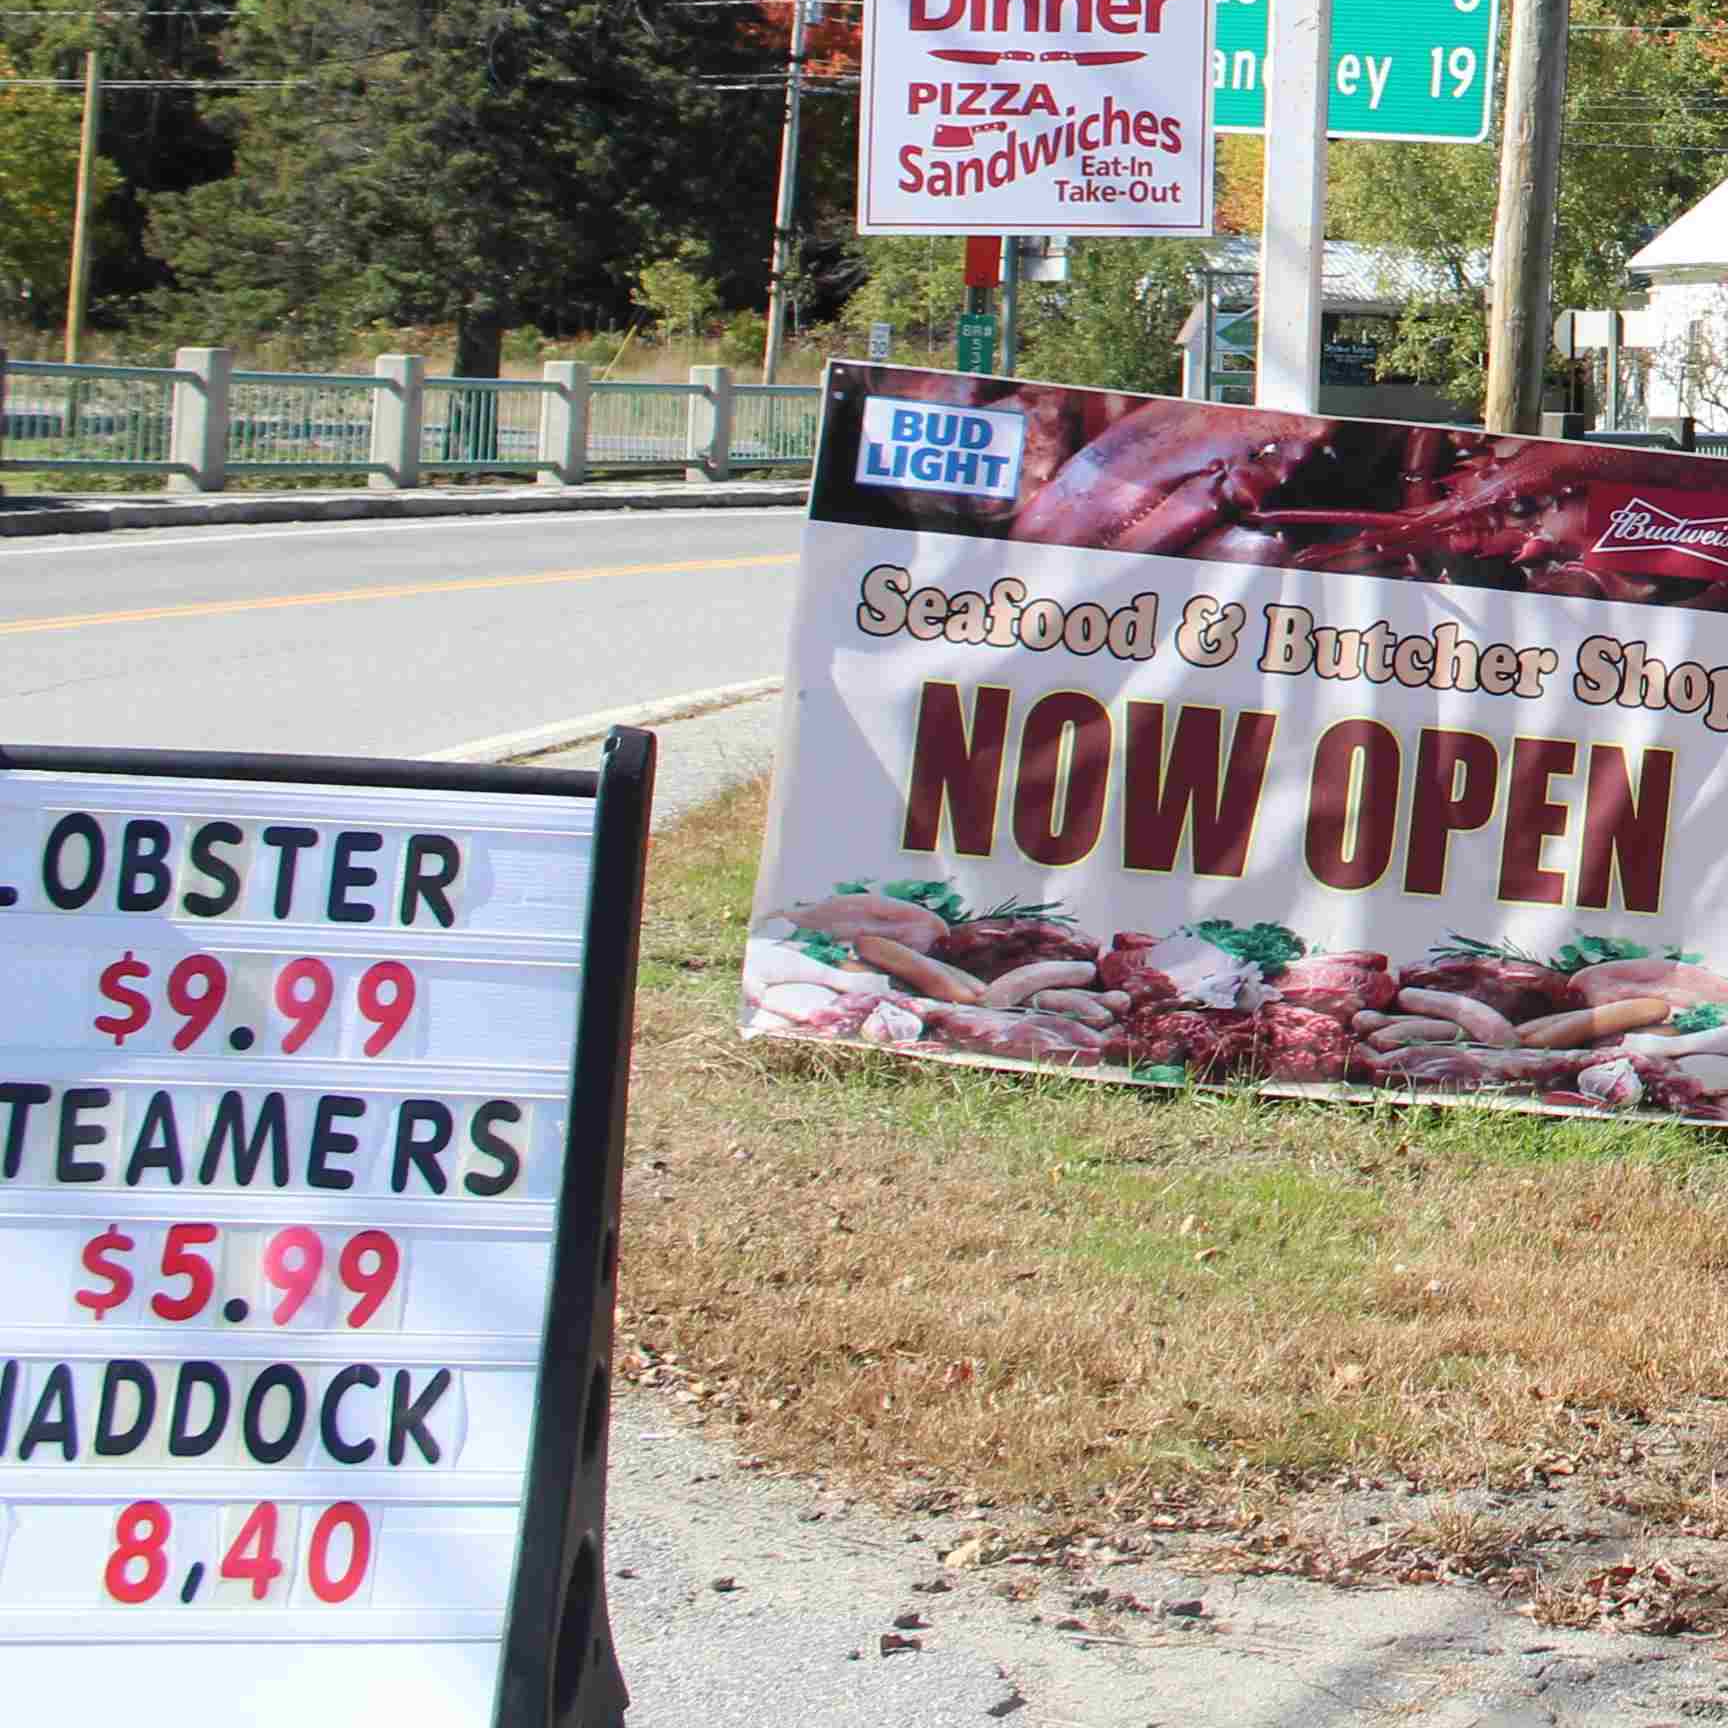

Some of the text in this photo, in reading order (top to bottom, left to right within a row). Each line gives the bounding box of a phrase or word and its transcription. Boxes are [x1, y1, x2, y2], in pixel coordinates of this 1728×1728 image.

[906, 83, 1060, 116] PIZZA
[1429, 47, 1477, 98] 19
[899, 95, 1182, 197] Sandwiches
[1081, 155, 1153, 177] Eat-In
[1053, 179, 1183, 203] Take-Out
[866, 443, 1010, 488] LIGHT
[891, 409, 993, 450] BUD
[857, 564, 1159, 661] Seafood
[1176, 596, 1246, 667] &
[1258, 604, 1558, 698] Butcher
[901, 680, 1678, 917] NOW OPEN
[0, 812, 463, 929] OBSTER
[94, 951, 417, 1058] $9.99
[74, 1223, 400, 1330] $5.99
